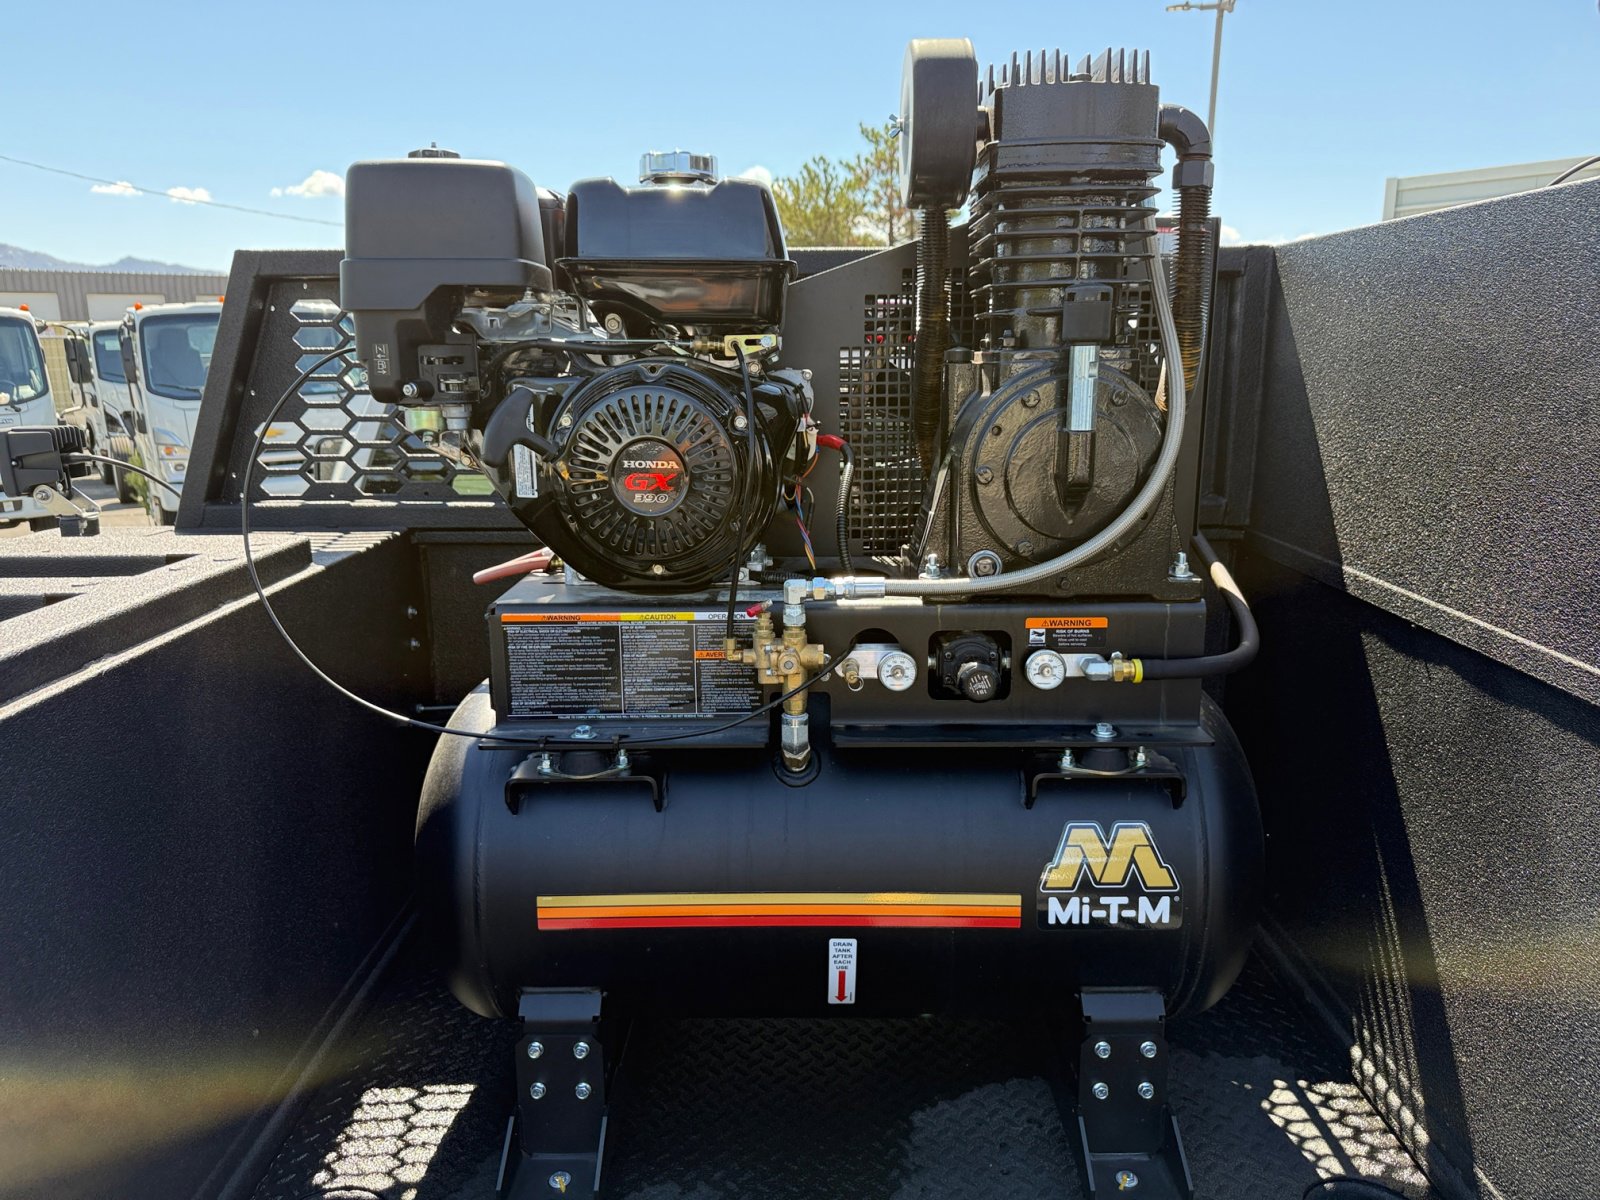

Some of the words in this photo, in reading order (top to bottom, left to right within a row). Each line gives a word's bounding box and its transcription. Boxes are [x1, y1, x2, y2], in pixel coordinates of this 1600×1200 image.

[623, 460, 679, 469] HONDA
[624, 472, 677, 491] GX
[633, 493, 669, 503] 390
[1049, 619, 1092, 627] WARNING
[1048, 896, 1170, 924] Mi-T-M
